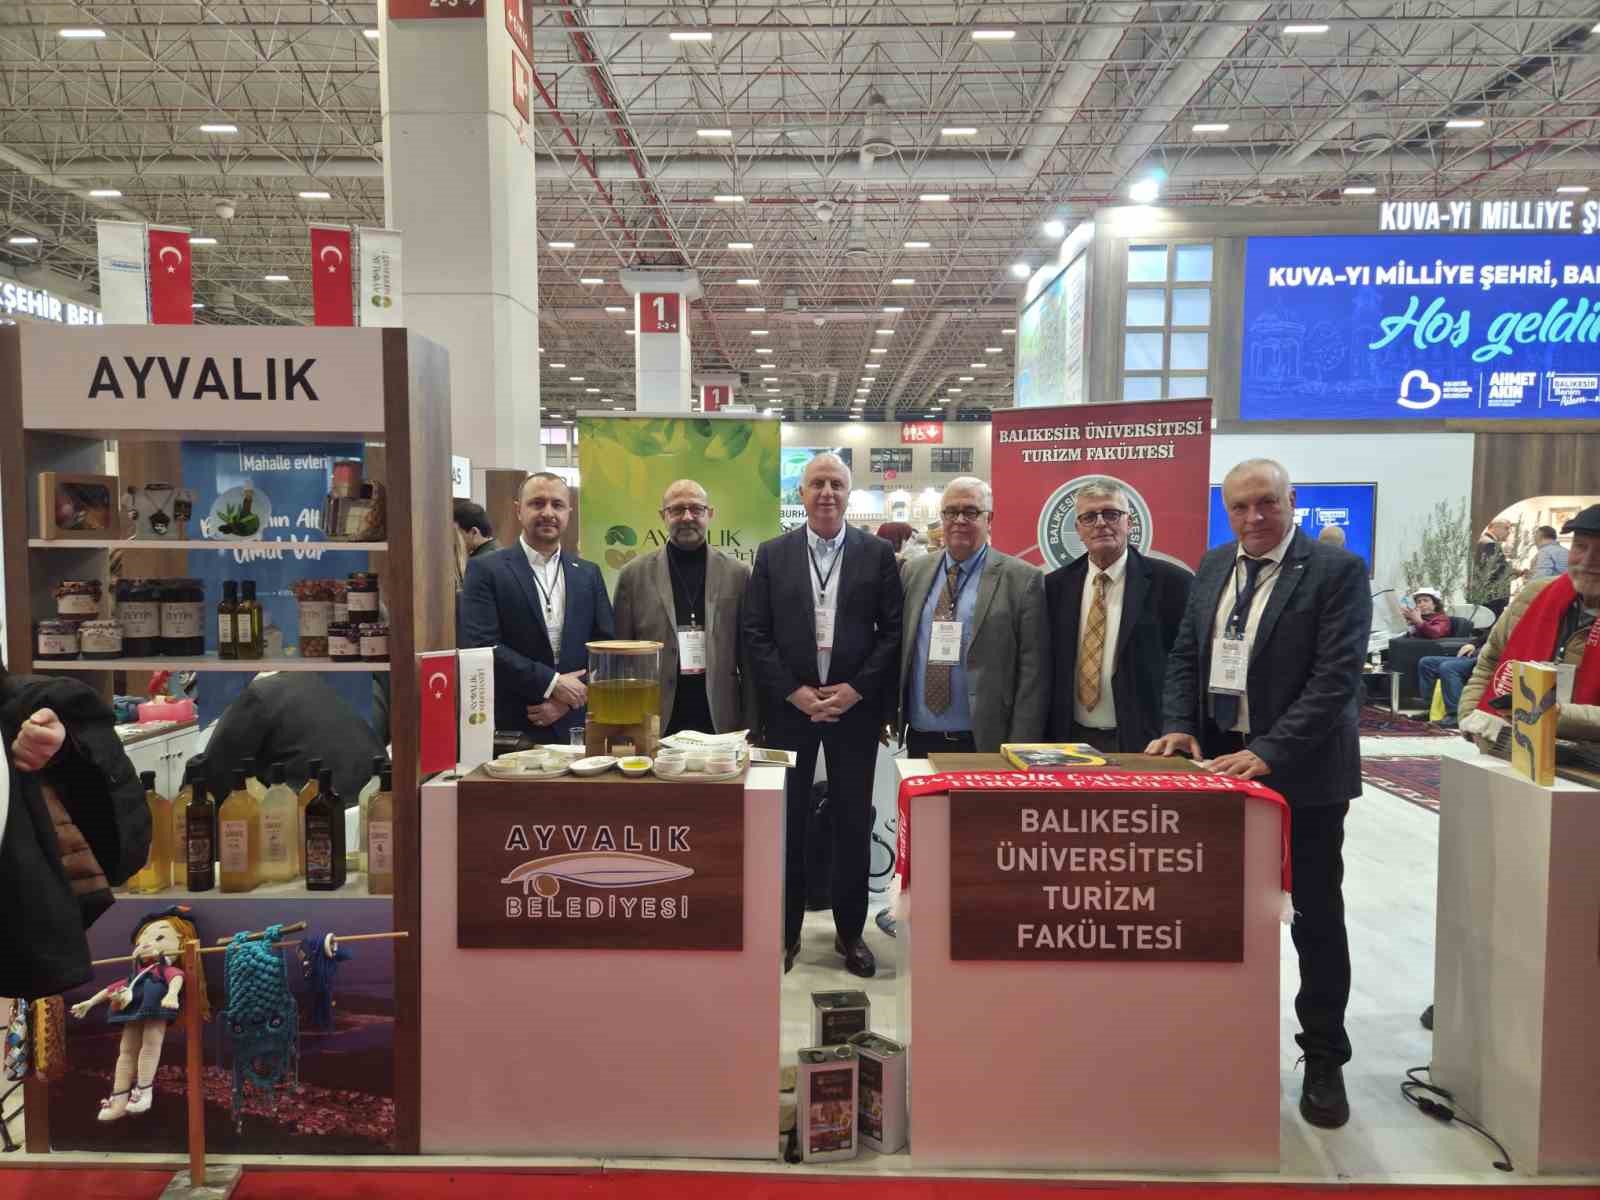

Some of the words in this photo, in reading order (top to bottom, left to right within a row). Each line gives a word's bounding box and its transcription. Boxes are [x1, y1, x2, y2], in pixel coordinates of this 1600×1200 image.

[1268, 267, 1369, 287] KUVA-YI
[1376, 259, 1474, 285] MİLLİYE
[1480, 259, 1558, 290] ŞEHRİ,
[0, 282, 62, 322] ŞEHİR
[652, 296, 665, 321] 1
[88, 356, 320, 401] AYVALIK
[999, 423, 1080, 443] BALIKESİR
[1085, 416, 1203, 440] ÜNİVERSİTESİ
[1022, 444, 1081, 463] TURİZM
[1087, 440, 1175, 461] FAKÜLTESİ
[1020, 803, 1180, 834] BALIKESİR
[504, 824, 692, 852] AYVALIK
[996, 840, 1204, 873] ÜNİVERSİTESİ
[505, 894, 689, 919] BELEDİYESİ
[1042, 880, 1155, 911] TURİZM
[1017, 918, 1182, 950] FAKÜLTESİ
